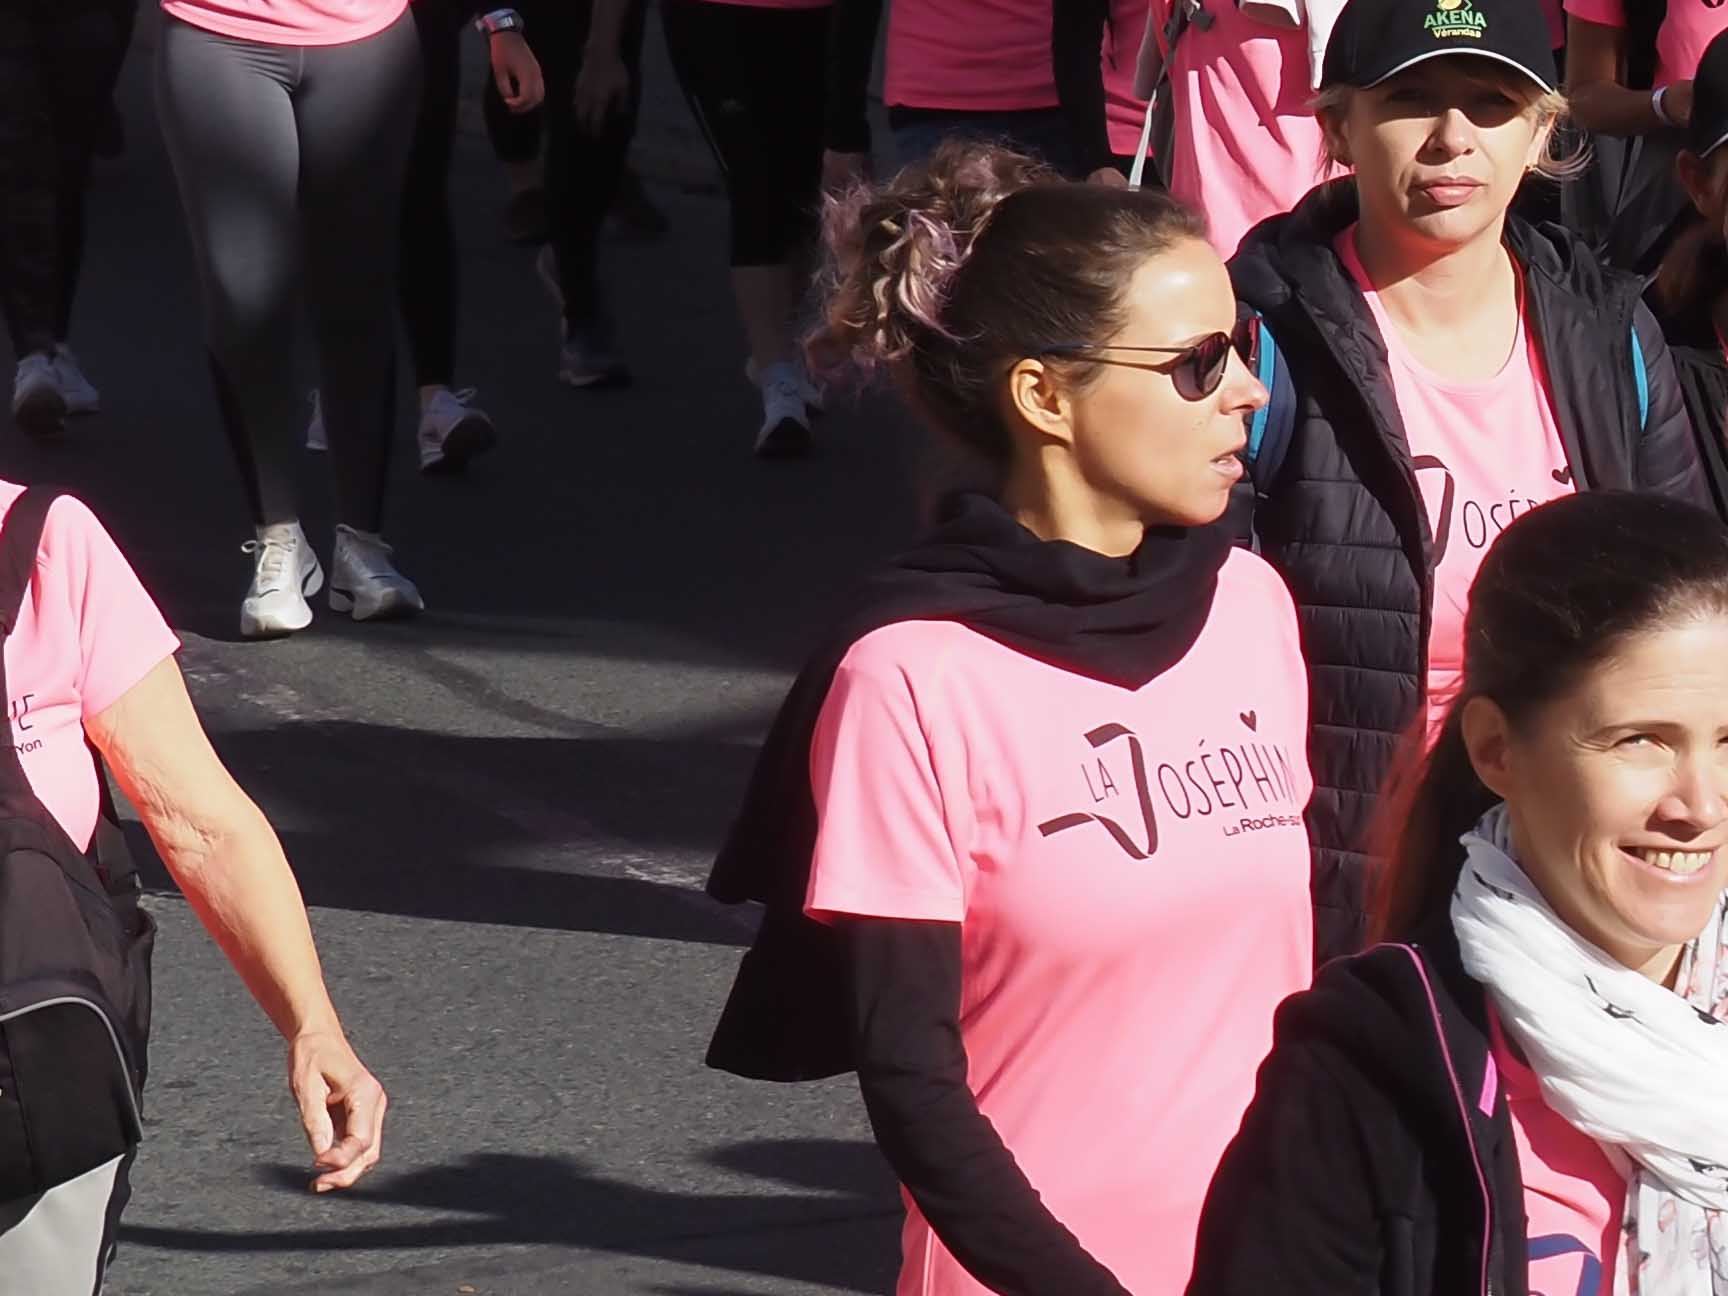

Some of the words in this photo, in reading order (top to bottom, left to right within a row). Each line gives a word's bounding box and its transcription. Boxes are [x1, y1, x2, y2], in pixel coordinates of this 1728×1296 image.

[1423, 9, 1488, 29] AKENA
[1080, 757, 1120, 804] LA
[1083, 722, 1300, 861] JOSÉPHIN
[1222, 823, 1241, 837] La
